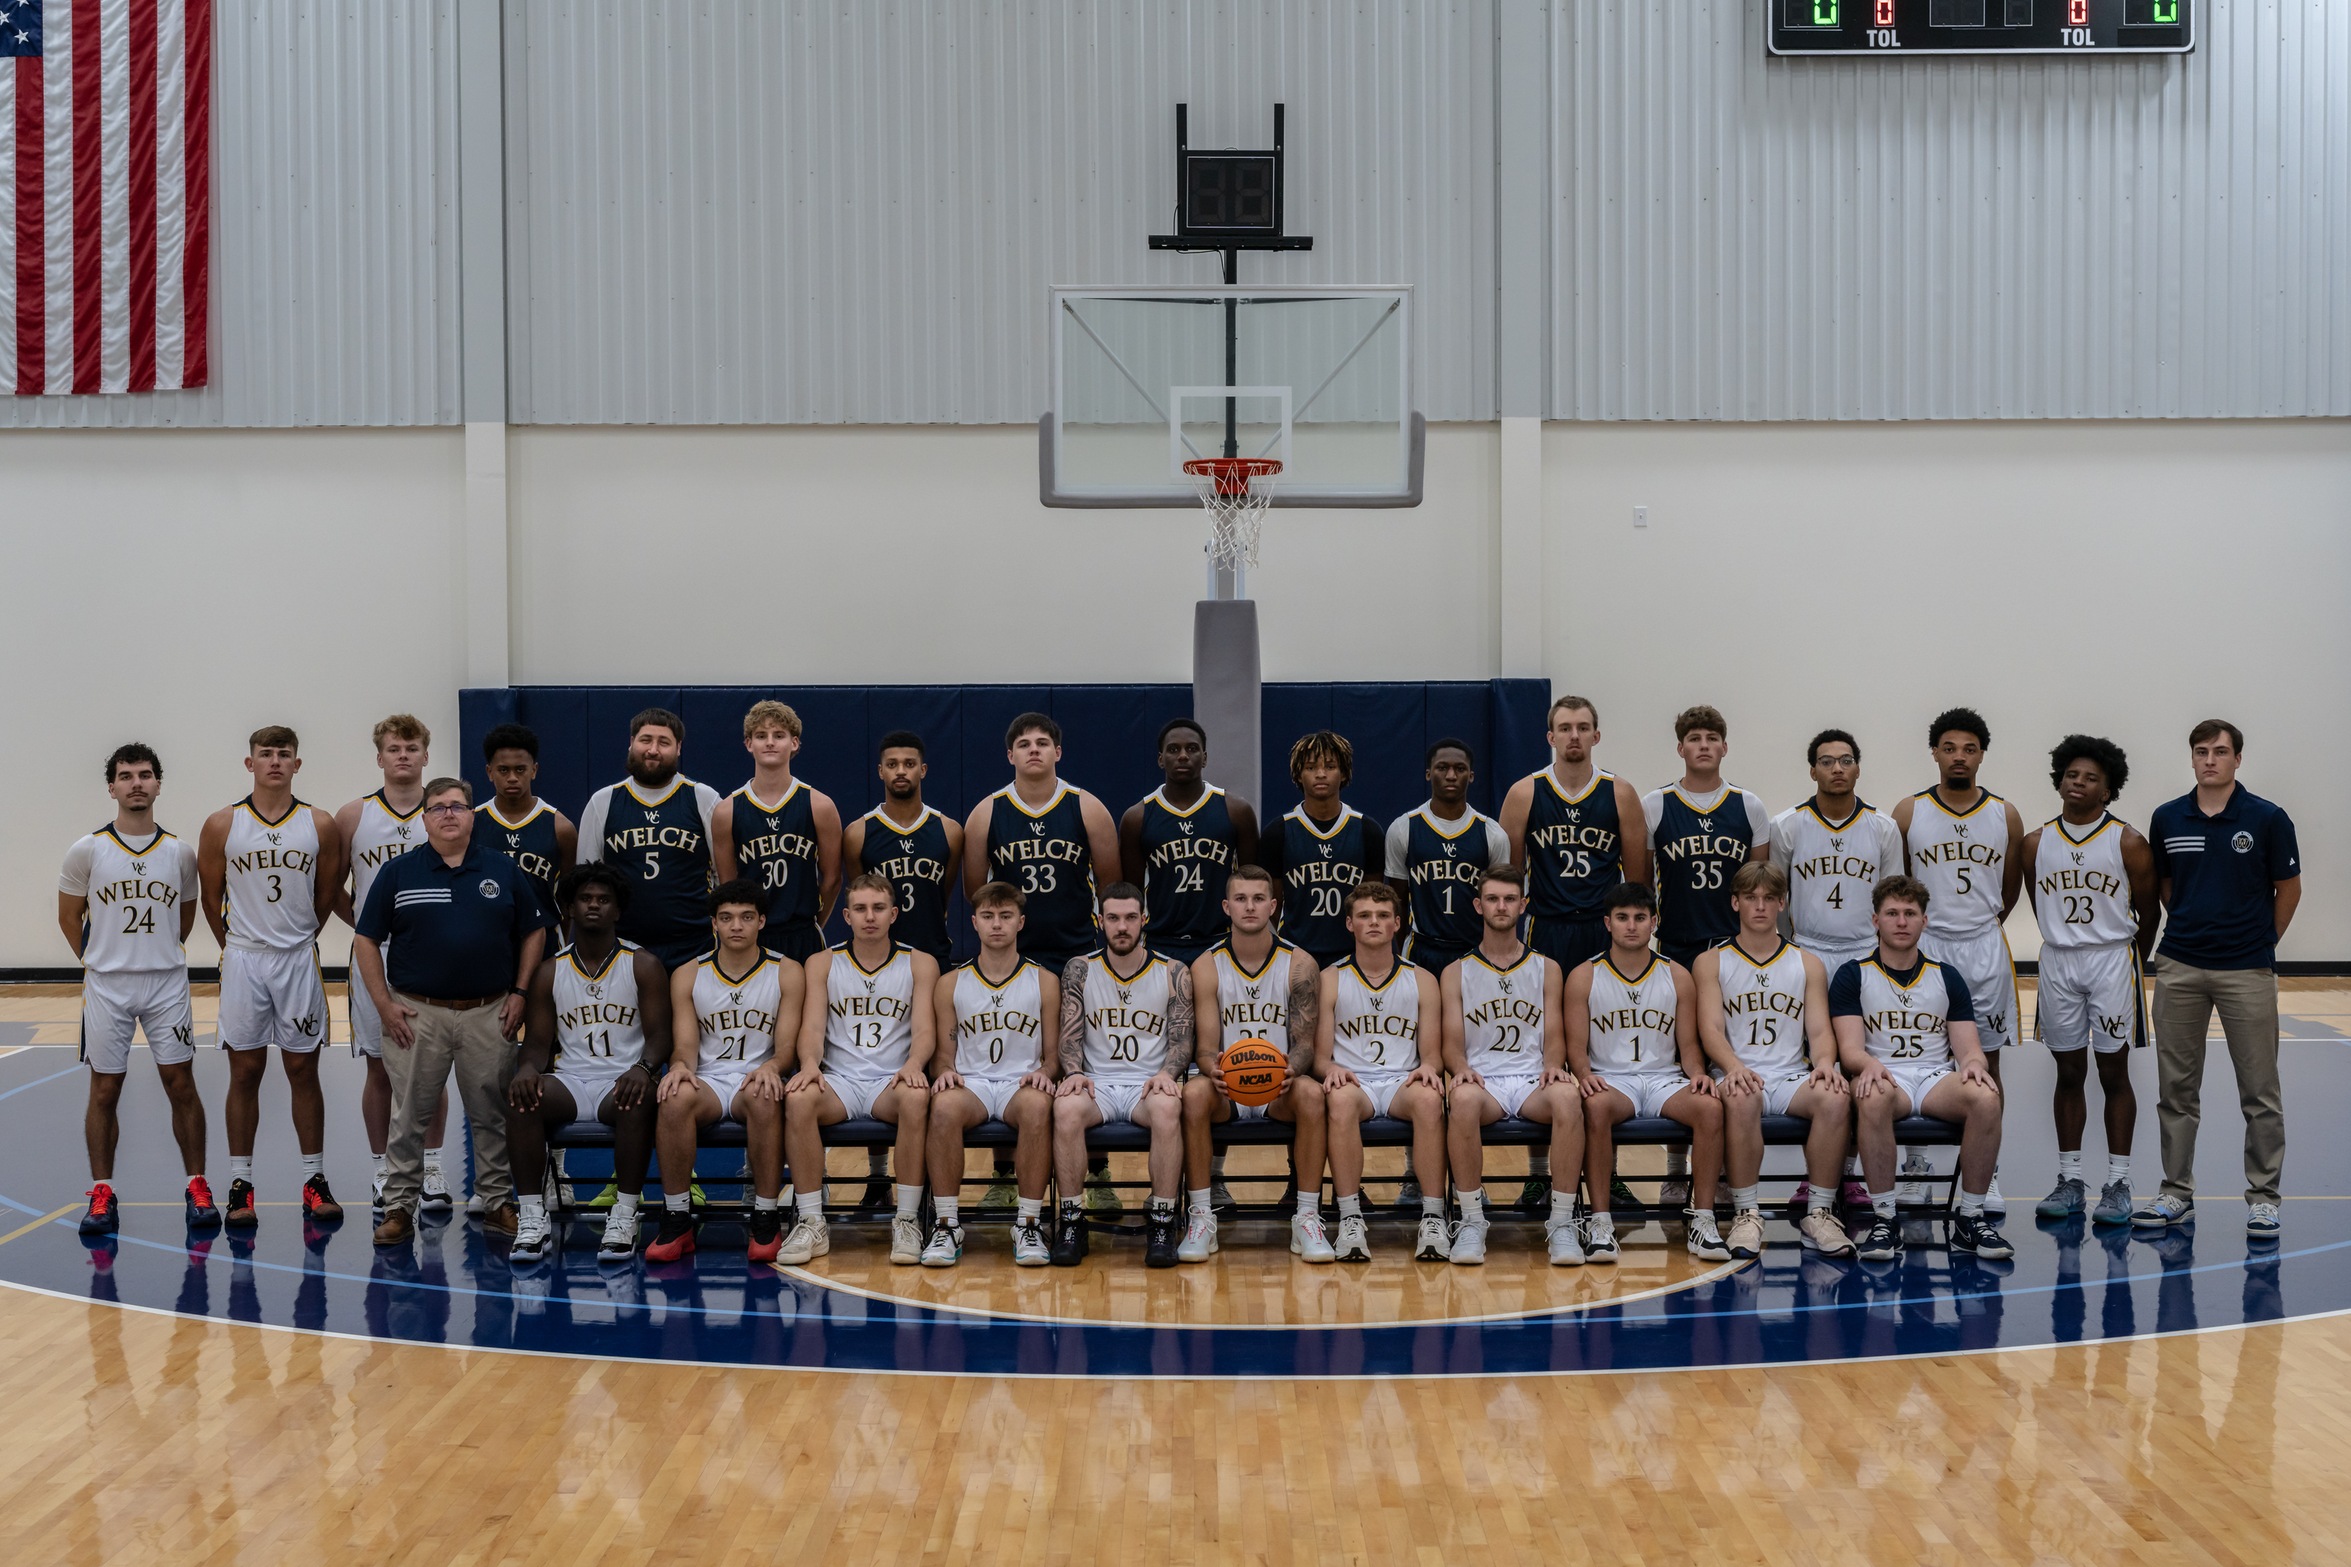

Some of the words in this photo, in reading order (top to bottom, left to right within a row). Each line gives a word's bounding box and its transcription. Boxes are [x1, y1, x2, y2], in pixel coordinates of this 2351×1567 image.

[1866, 30, 1901, 47] TOL
[2060, 28, 2096, 46] TOL
[606, 827, 700, 853] WELCH
[740, 834, 814, 864] WELCH
[994, 839, 1083, 866] WELCH
[1532, 825, 1616, 852] WELCH
[1663, 835, 1748, 864] WELCH
[230, 849, 314, 876] WELCH
[644, 852, 660, 880] 5
[1150, 838, 1229, 868] WELCH
[1560, 850, 1591, 878] 25
[1915, 842, 2002, 869] WELCH
[761, 858, 788, 890] 30
[1022, 864, 1057, 894] 33
[1174, 864, 1204, 893] 24
[1286, 862, 1364, 888] WELCH
[1692, 860, 1722, 890] 35
[1794, 856, 1876, 884] WELCH
[1956, 867, 1972, 895] 5
[2038, 870, 2120, 898] WELCH
[96, 879, 180, 910] WELCH
[266, 874, 282, 903] 3
[902, 882, 915, 912] 3
[1310, 888, 1342, 916] 20
[1442, 886, 1455, 914] 1
[1826, 882, 1844, 910] 4
[122, 906, 156, 934] 24
[2064, 896, 2094, 924] 23
[559, 1004, 638, 1031] WELCH
[829, 996, 910, 1022] WELCH
[1222, 1002, 1288, 1028] WELCH
[1465, 998, 1544, 1028] WELCH
[1723, 991, 1804, 1020] WELCH
[698, 1009, 775, 1036] WELCH
[852, 1022, 882, 1048] 13
[959, 1010, 1040, 1038] WELCH
[1086, 1008, 1166, 1036] WELCH
[1338, 1015, 1418, 1041] WELCH
[1590, 1008, 1674, 1036] WELCH
[1748, 1018, 1776, 1046] 15
[584, 1030, 614, 1058] 11
[716, 1034, 746, 1060] 21
[989, 1038, 1004, 1064] 0
[1108, 1034, 1140, 1062] 20
[1489, 1024, 1522, 1053] 22
[1630, 1035, 1642, 1062] 1
[1890, 1034, 1924, 1058] 25
[1230, 1050, 1278, 1066] Wilson
[1370, 1040, 1386, 1066] 2
[1239, 1072, 1273, 1085] NCAA
